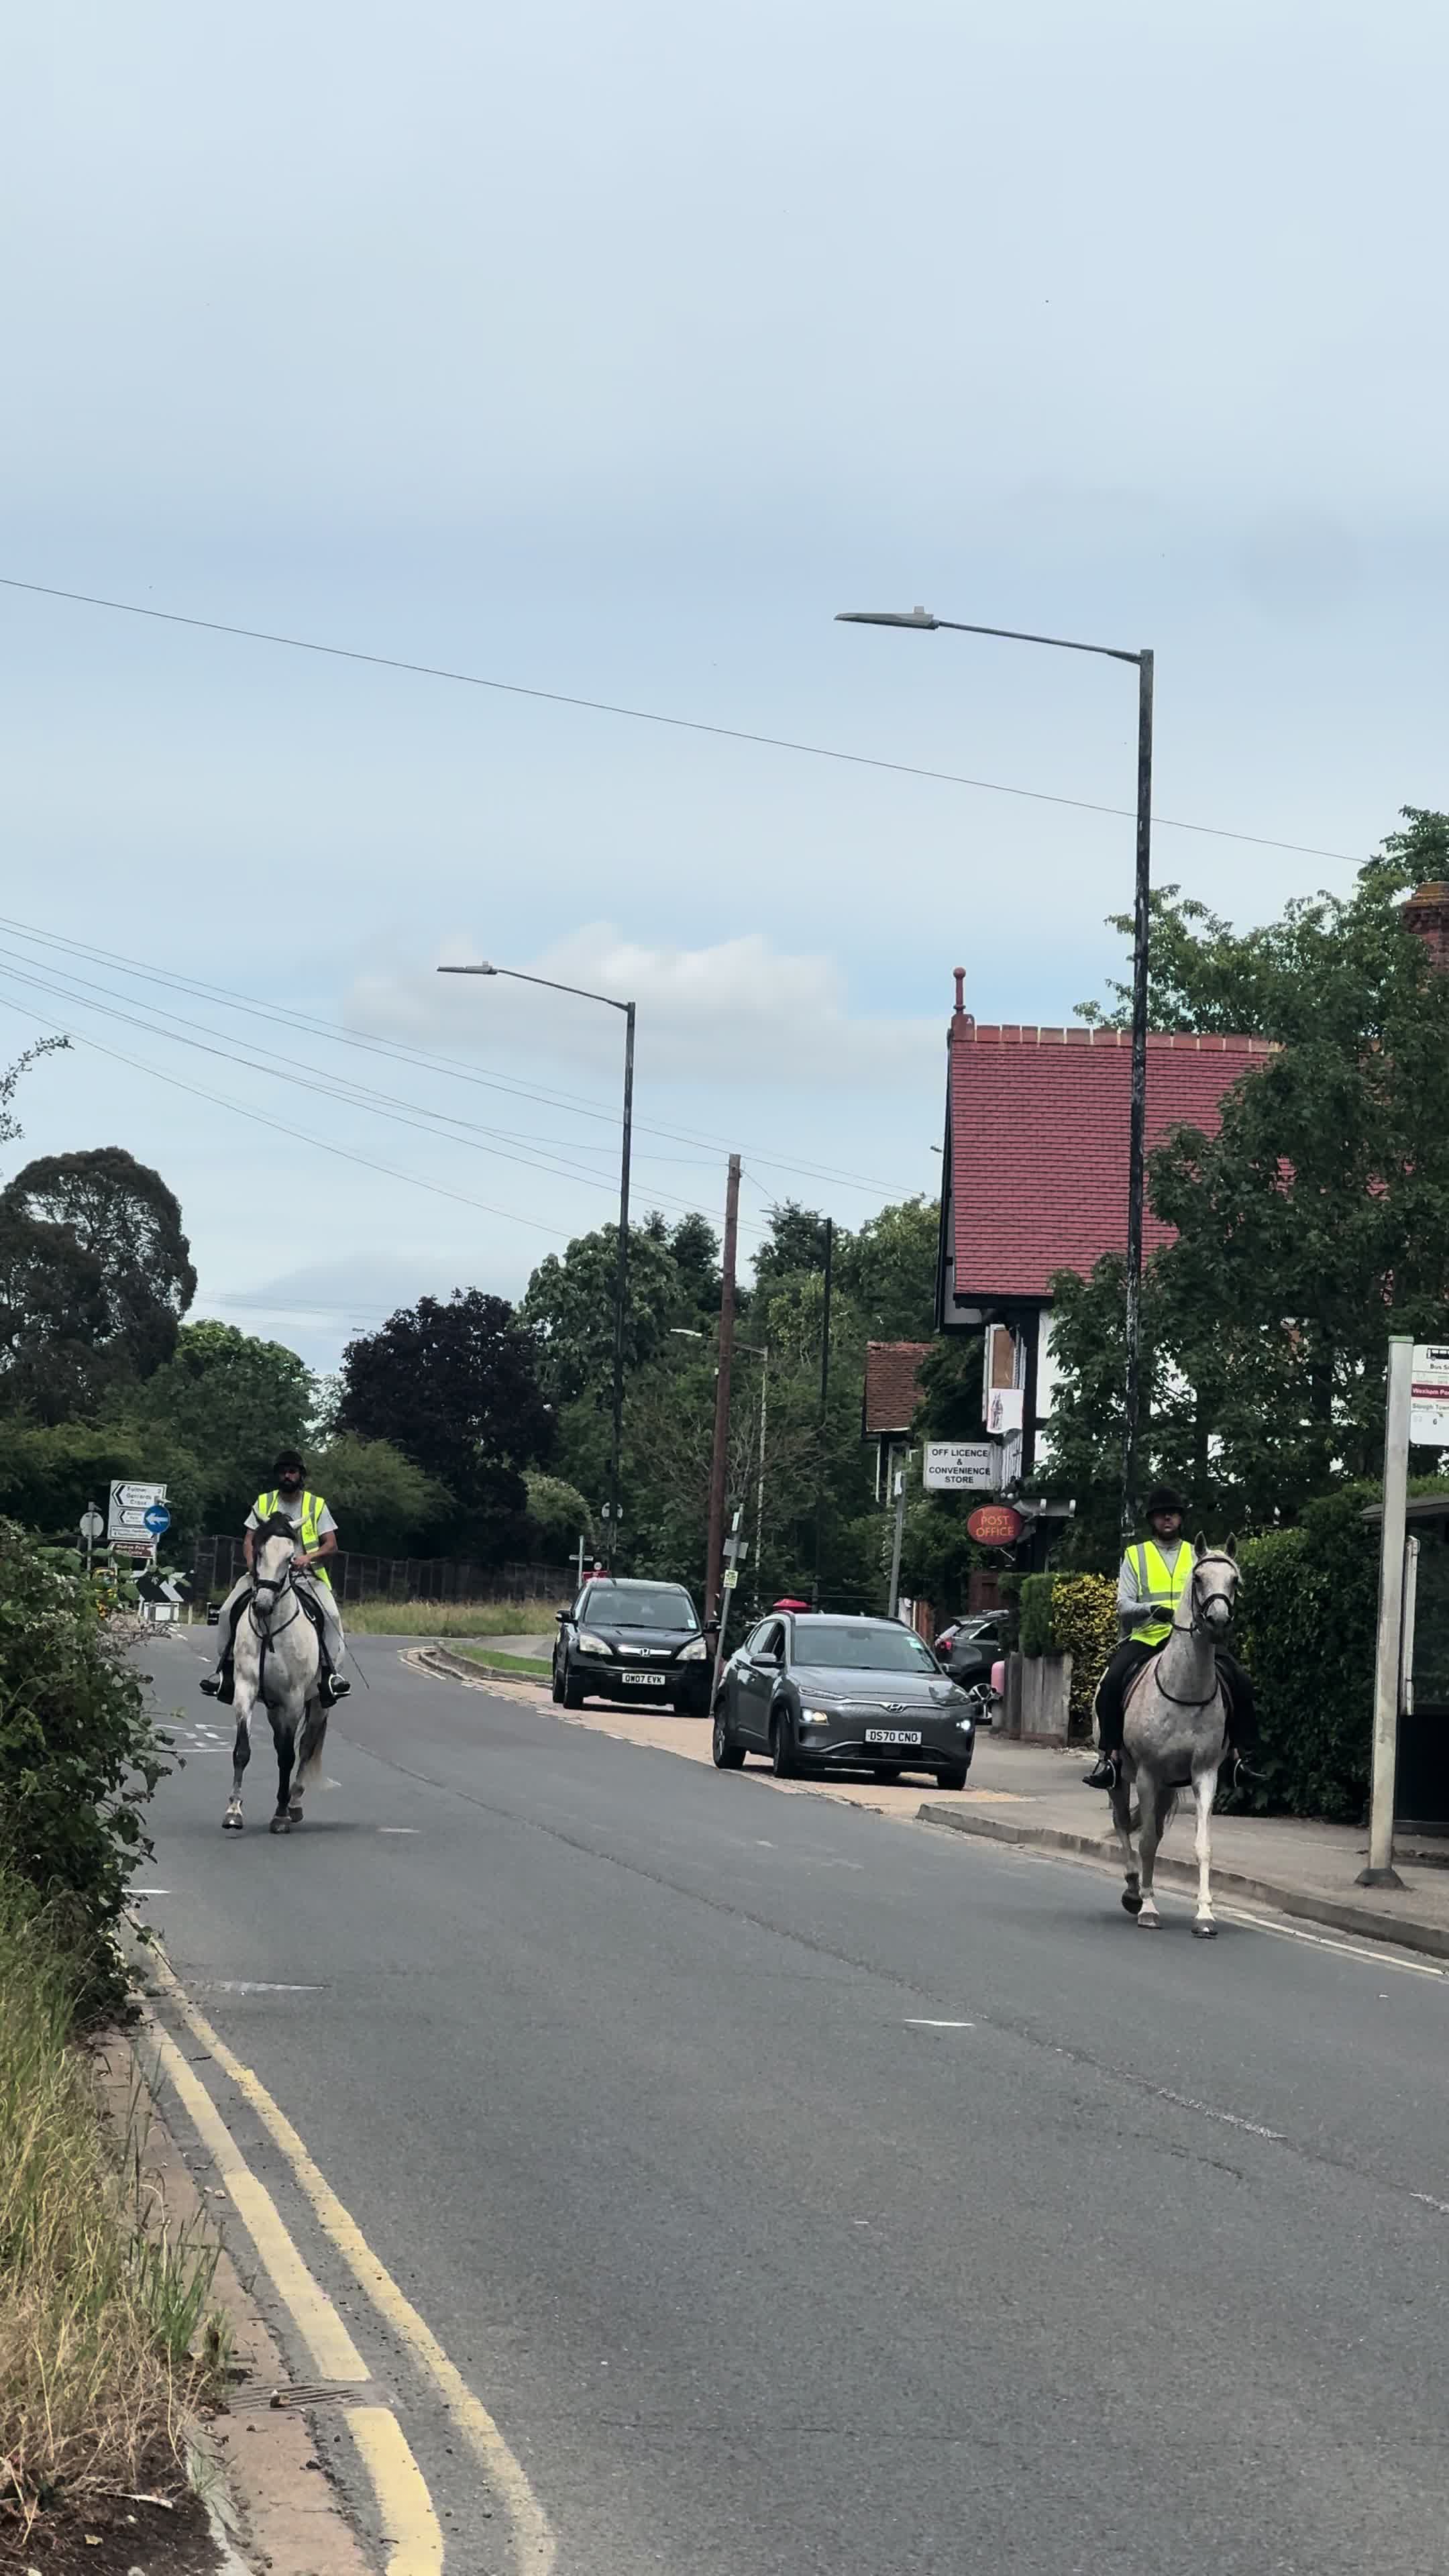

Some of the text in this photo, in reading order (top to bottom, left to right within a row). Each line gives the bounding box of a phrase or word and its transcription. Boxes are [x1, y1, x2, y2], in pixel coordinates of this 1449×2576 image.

[951, 1449, 988, 1457] LICENCE
[928, 1466, 991, 1476] CONVENIENCE
[981, 1515, 1010, 1525] POST
[976, 1526, 1014, 1536] OFFICE
[870, 1731, 918, 1742] DS70 CNO
